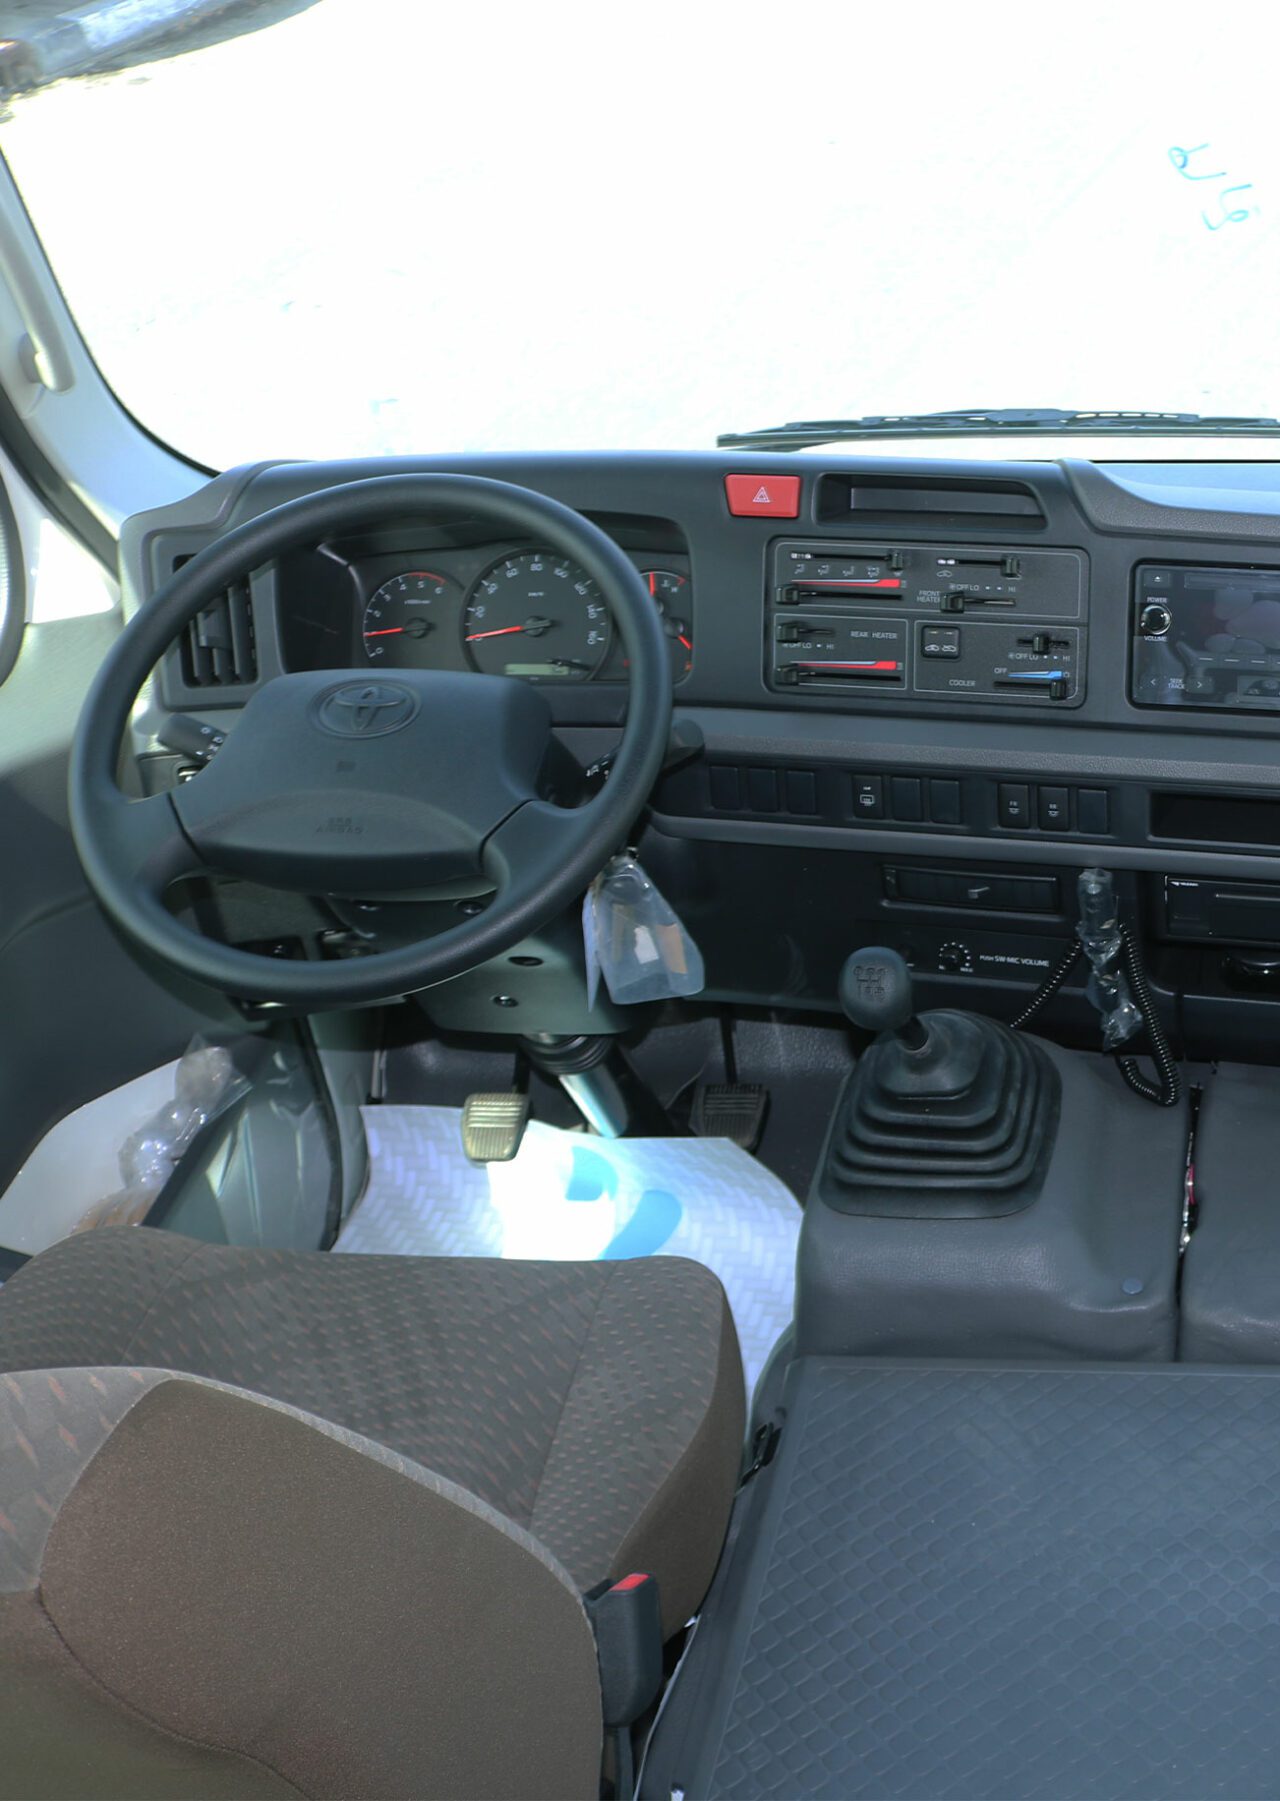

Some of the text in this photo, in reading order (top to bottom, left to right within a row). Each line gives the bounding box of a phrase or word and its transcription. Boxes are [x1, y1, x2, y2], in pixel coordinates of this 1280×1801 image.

[850, 630, 868, 638] REAR
[949, 679, 976, 687] COOLER
[1021, 958, 1050, 968] VOLUME
